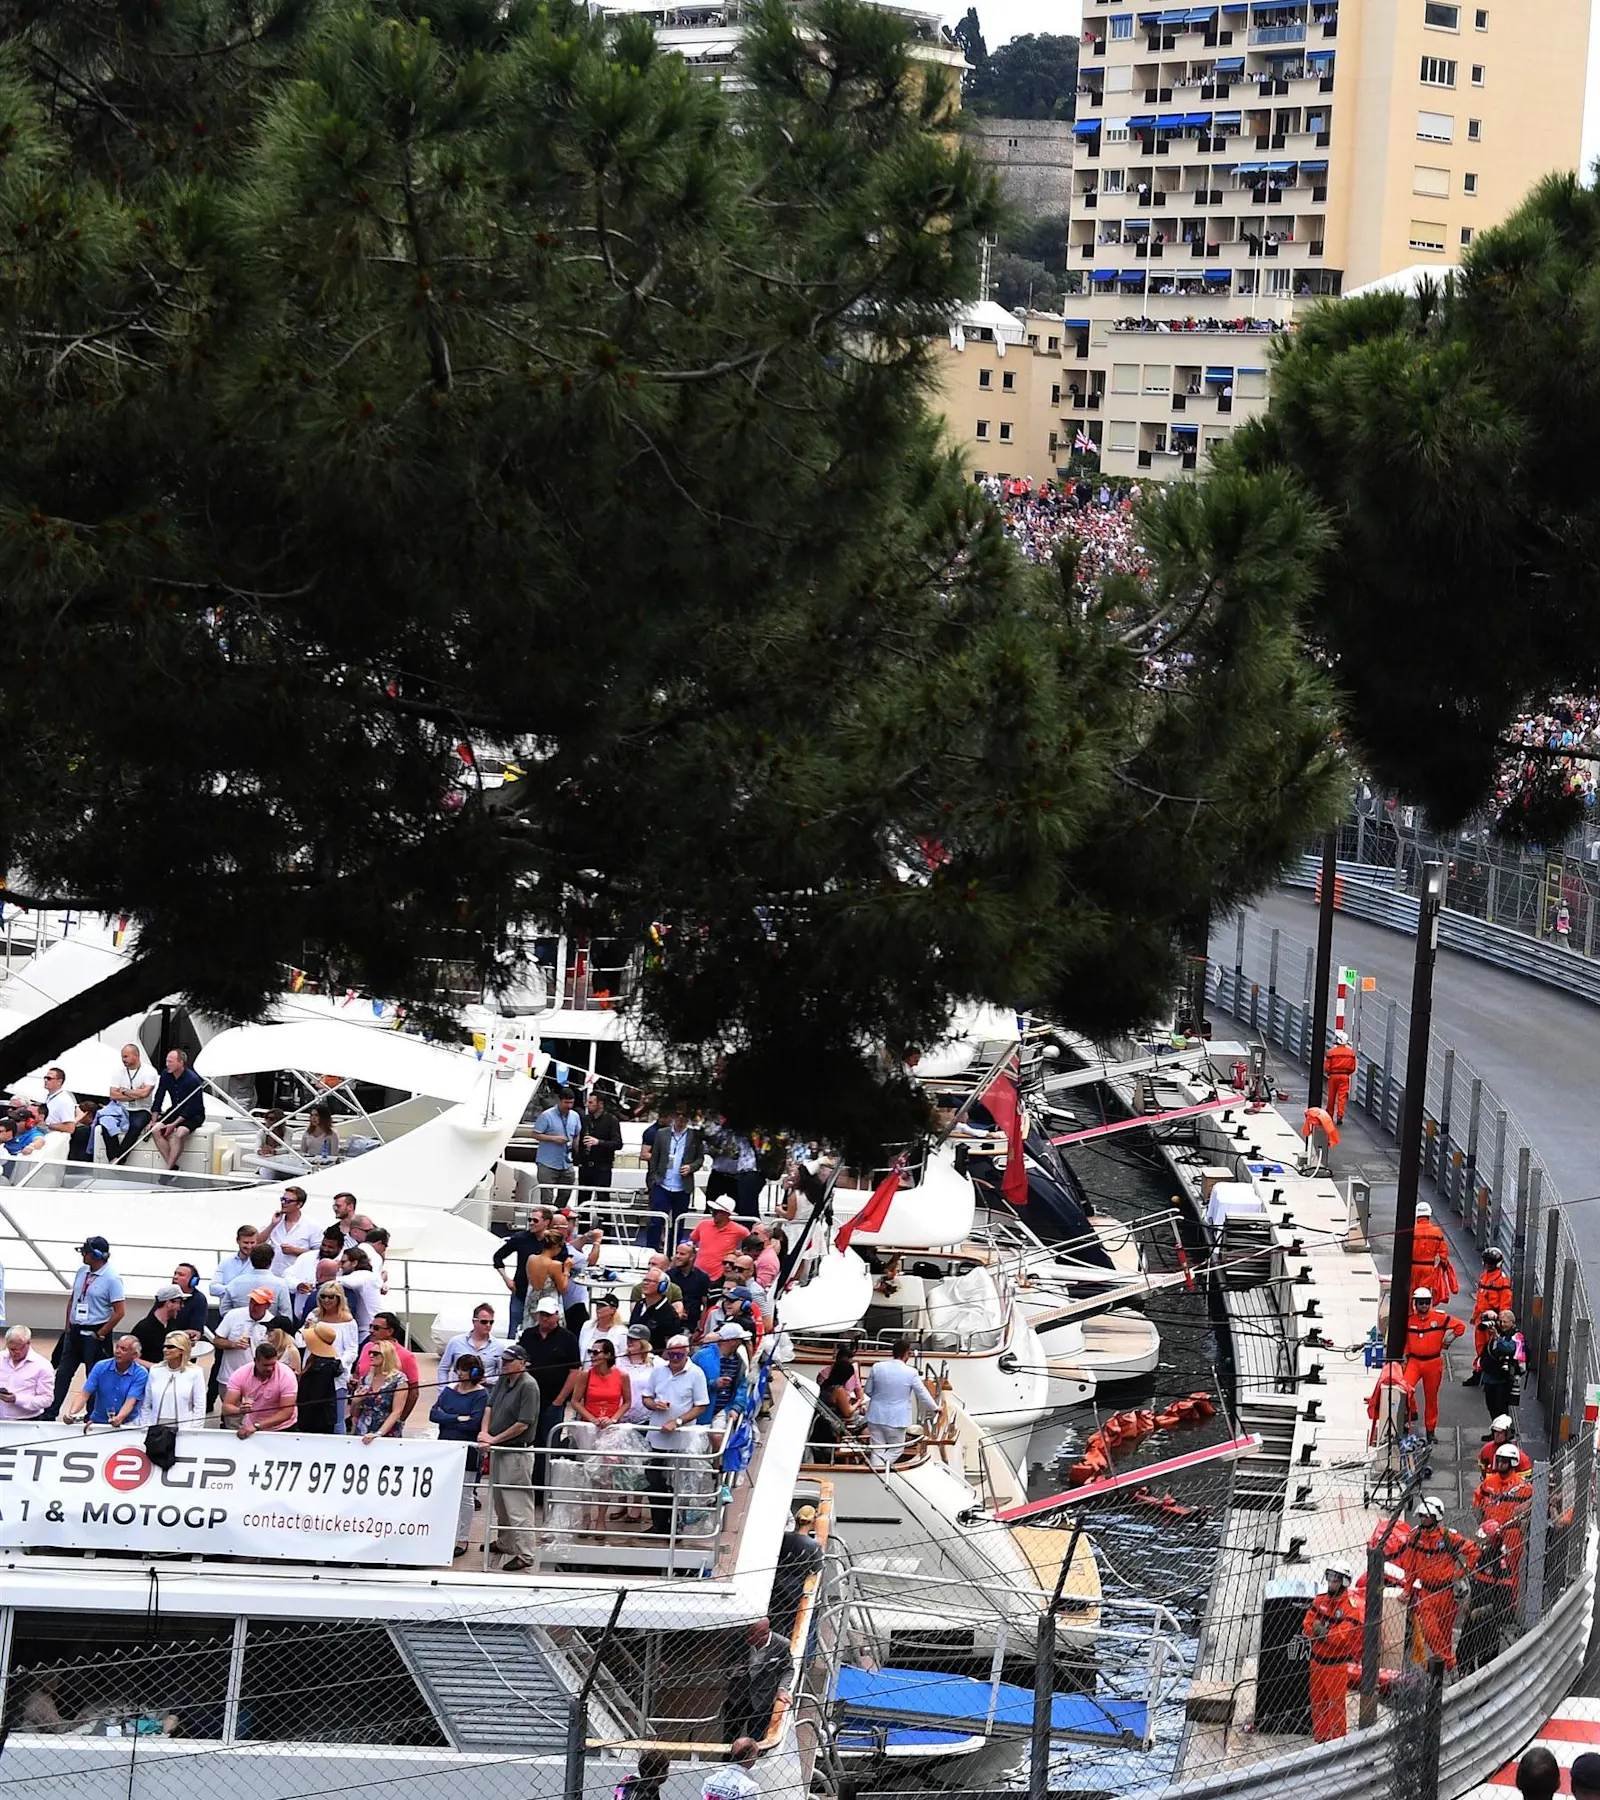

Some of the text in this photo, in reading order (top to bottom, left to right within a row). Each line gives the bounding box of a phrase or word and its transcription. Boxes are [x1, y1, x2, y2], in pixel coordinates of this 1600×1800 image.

[248, 1460, 434, 1498] +377 97 98 63 18
[21, 1500, 30, 1522] 1
[45, 1500, 65, 1523] &
[82, 1501, 228, 1529] MOTOGP
[243, 1512, 429, 1538] contact@tickets2gp.com
